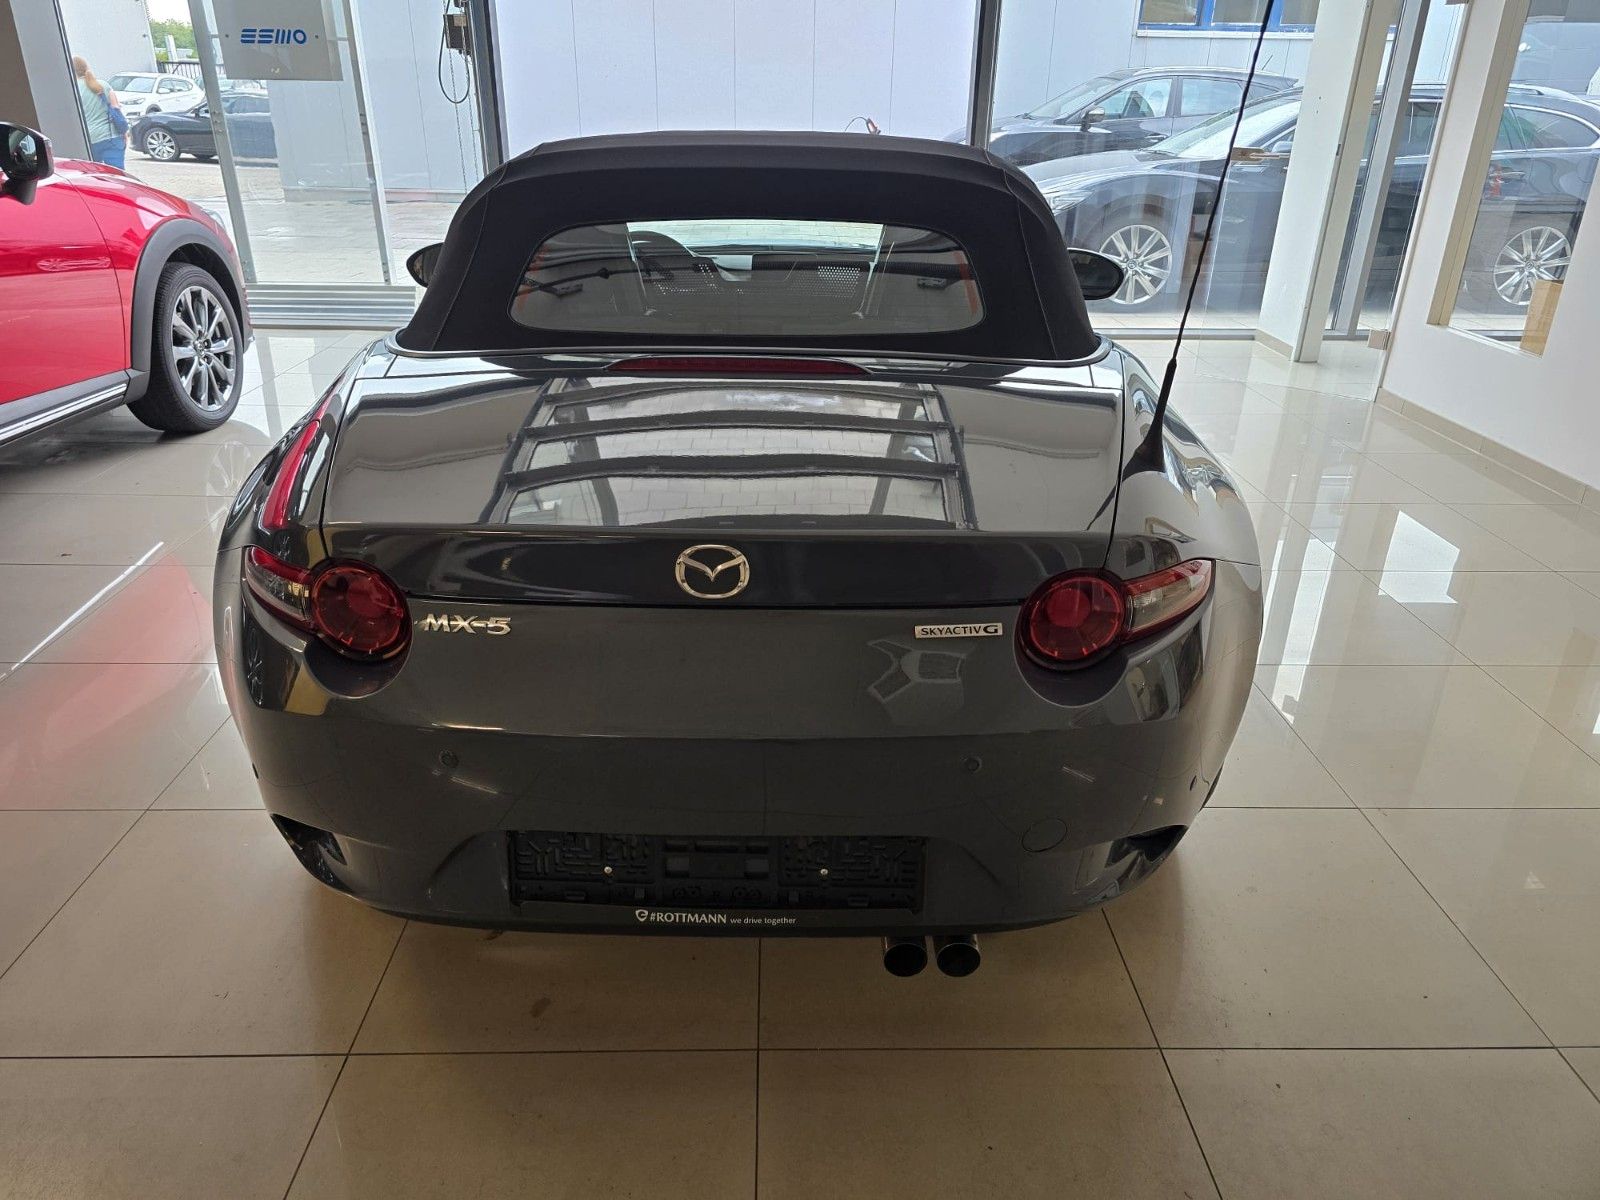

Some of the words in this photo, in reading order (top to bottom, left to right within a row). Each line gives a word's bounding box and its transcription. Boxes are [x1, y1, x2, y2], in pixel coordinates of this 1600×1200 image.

[419, 613, 511, 635] MX-5
[650, 912, 727, 924] #ROTTMANN
[743, 916, 762, 924] drive
[764, 916, 796, 926] together
